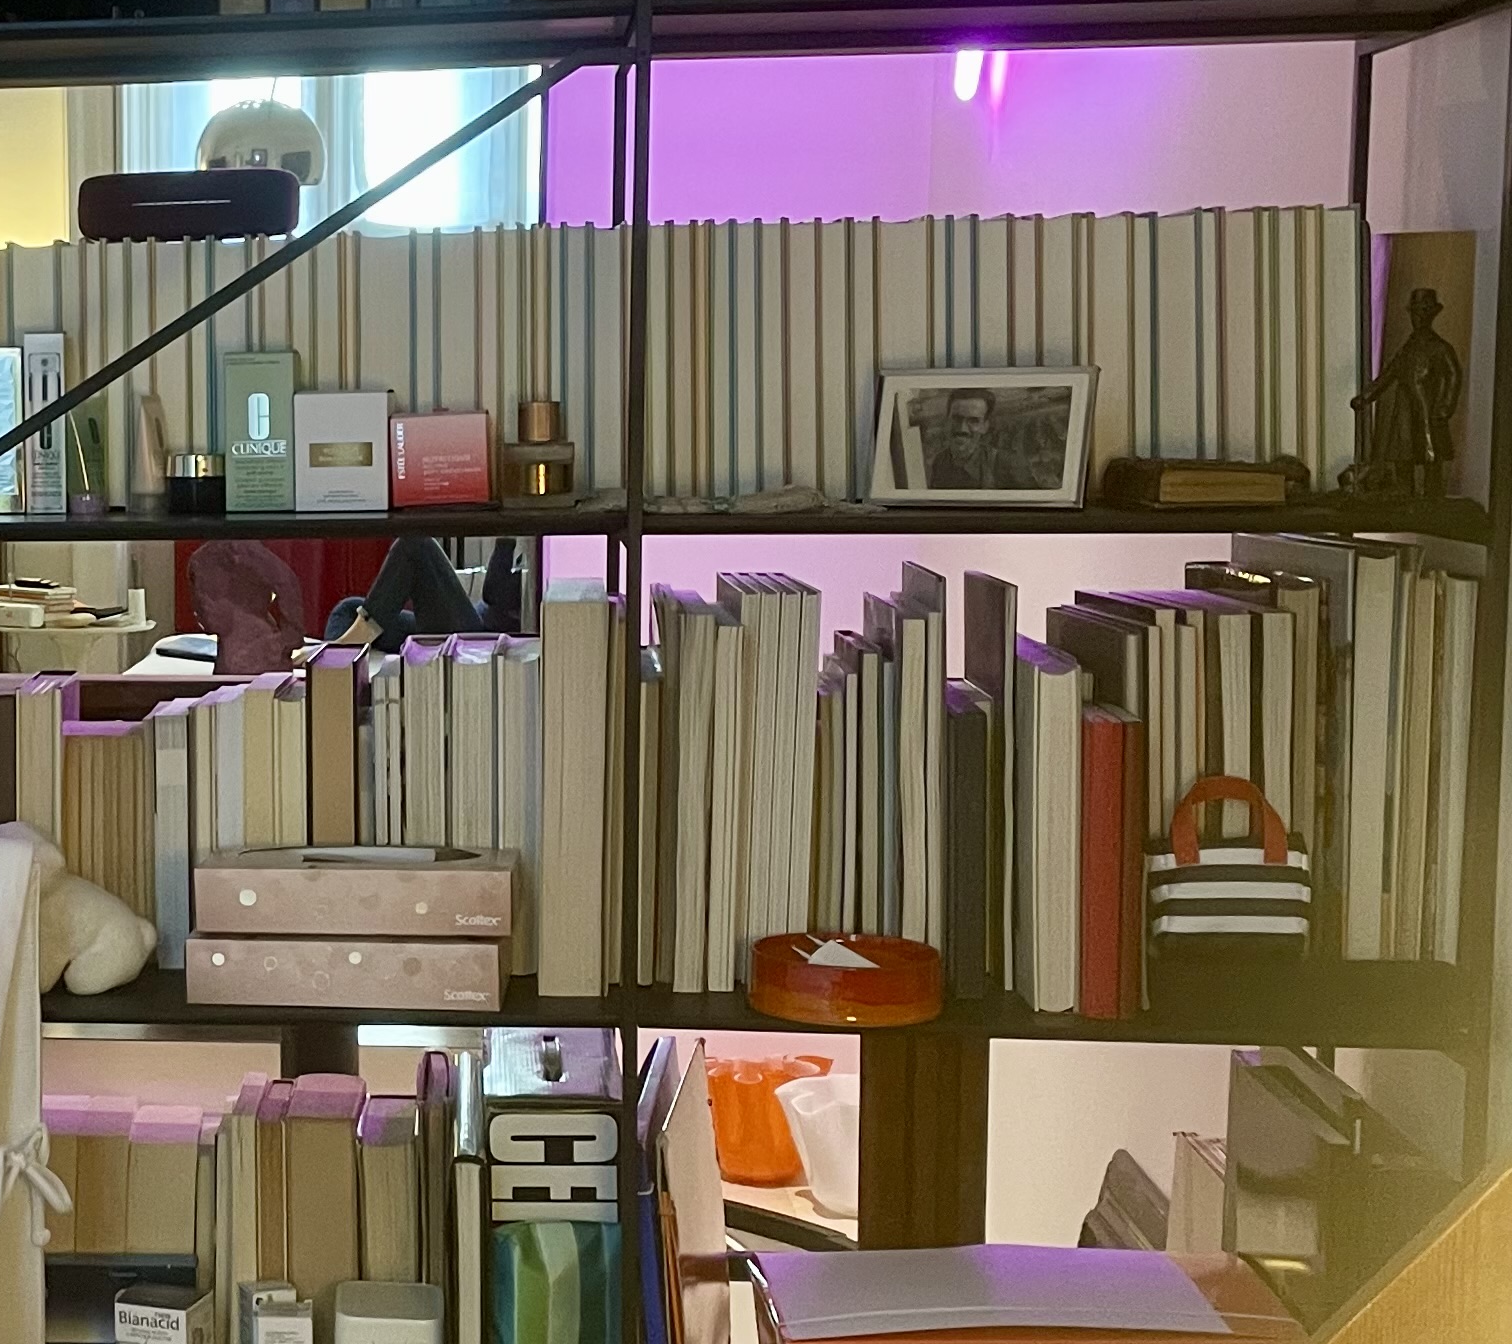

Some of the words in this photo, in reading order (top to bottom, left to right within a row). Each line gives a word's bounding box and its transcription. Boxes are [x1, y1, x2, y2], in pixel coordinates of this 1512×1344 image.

[231, 442, 287, 456] CLINIQUE
[455, 914, 502, 927] Scottex
[443, 988, 491, 1002] Scottex
